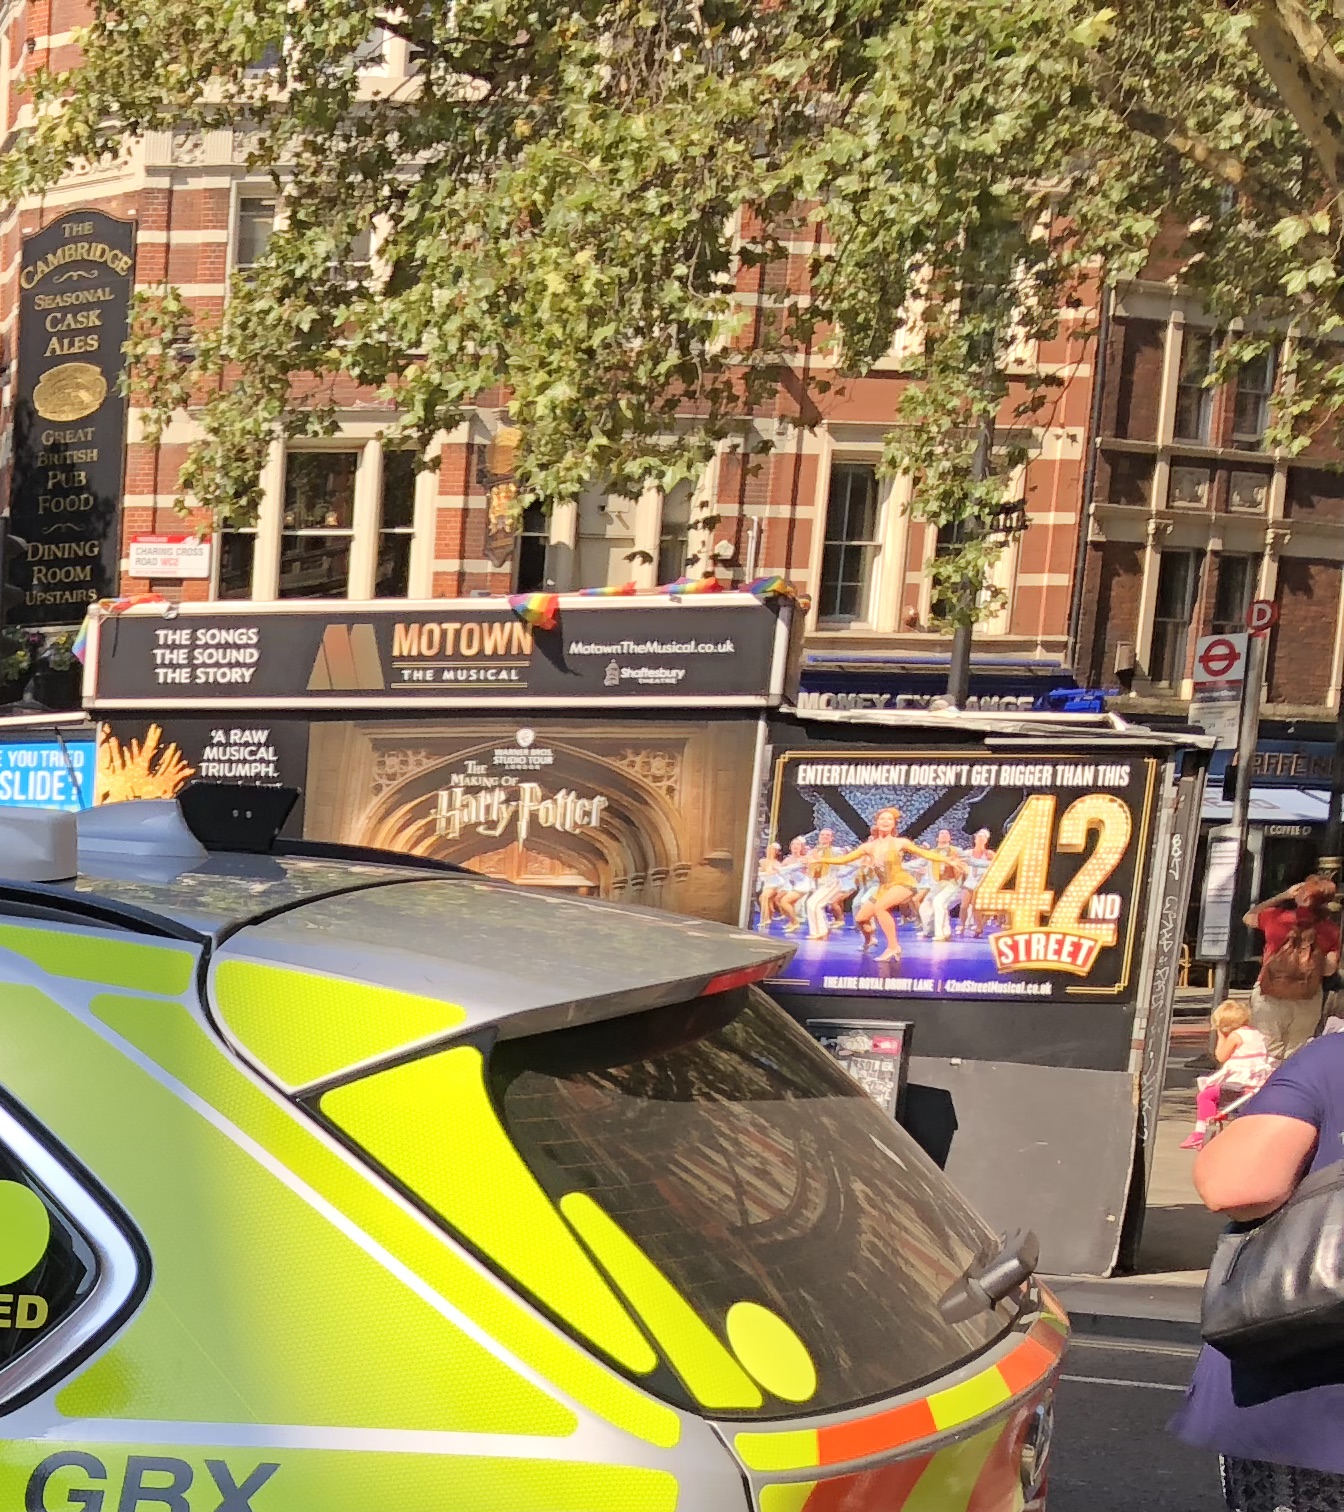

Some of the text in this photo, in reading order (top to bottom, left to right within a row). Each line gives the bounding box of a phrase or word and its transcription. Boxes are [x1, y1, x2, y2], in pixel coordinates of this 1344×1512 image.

[62, 221, 94, 238] THE
[20, 241, 133, 290] CAMBRIDGE
[34, 287, 116, 311] SEASONAL
[45, 309, 103, 333] CASK
[43, 334, 100, 357] ALES
[41, 427, 96, 446] GREAT
[36, 448, 99, 469] BRITISH
[47, 470, 87, 491] PUB
[37, 493, 95, 515] FOOD
[25, 540, 100, 563] DINING
[135, 547, 204, 557] CHARING CROSS
[134, 557, 180, 567] ROAD WC2
[32, 564, 93, 586] ROOM
[25, 588, 98, 607] UPSTAIRS
[1252, 603, 1272, 627] D
[154, 627, 260, 645] THE SONGS
[391, 621, 535, 658] MOTOWN
[568, 638, 736, 655] MotownTheMusical.co.uk
[152, 648, 261, 665] THE SOUND
[154, 666, 257, 684] THE STORY
[400, 668, 520, 682] THE MUSICAL
[620, 666, 687, 680] Shaftesbury
[797, 692, 891, 710] MONEY
[229, 728, 271, 744] RAW
[7, 750, 38, 768] YOU
[202, 745, 279, 761] MUSICAL
[492, 756, 554, 765] STUDIO TOUR
[463, 760, 488, 775] THE
[796, 764, 1131, 787] ENTERTAINMENT DOESN'T GET BIGGER THAN THIS
[450, 772, 520, 788] MAKING OF
[429, 782, 609, 854] Harry Potter
[998, 932, 1097, 967] STREET
[822, 976, 859, 990] THEATRE
[859, 977, 884, 990] ROYAL
[884, 977, 912, 991] DRURY
[913, 978, 935, 991] LANE
